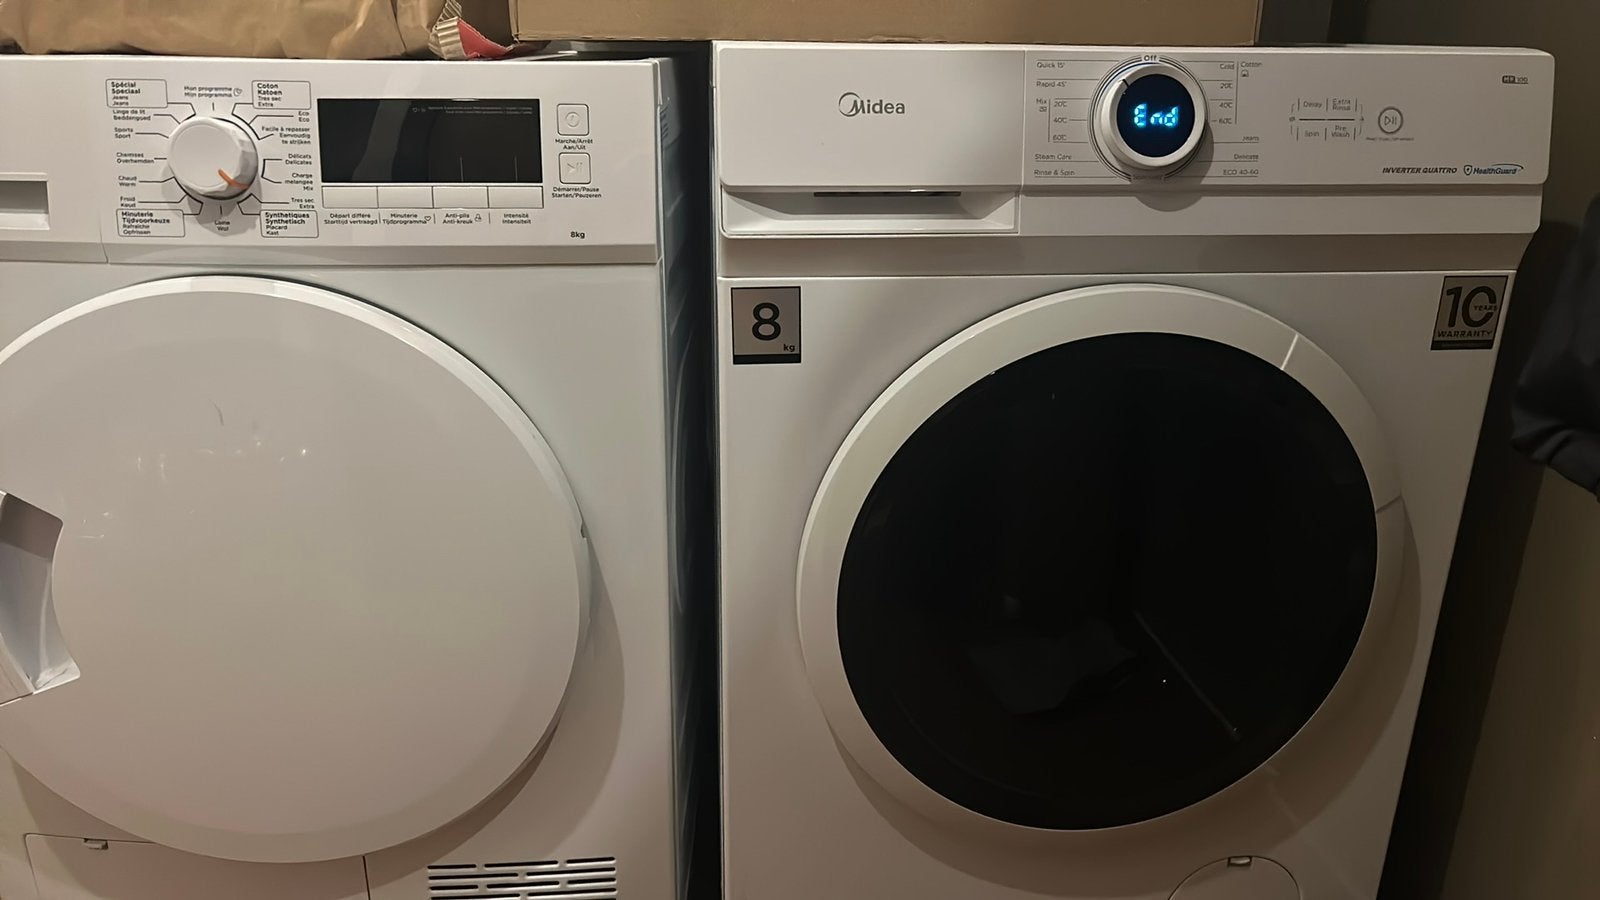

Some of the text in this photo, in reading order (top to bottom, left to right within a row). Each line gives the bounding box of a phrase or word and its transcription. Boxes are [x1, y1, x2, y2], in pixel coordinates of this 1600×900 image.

[839, 92, 905, 117] Midea
[1134, 103, 1179, 127] End
[570, 231, 585, 239] 8kg
[1446, 286, 1497, 327] 10
[752, 303, 781, 341] 8
[783, 344, 795, 352] kg
